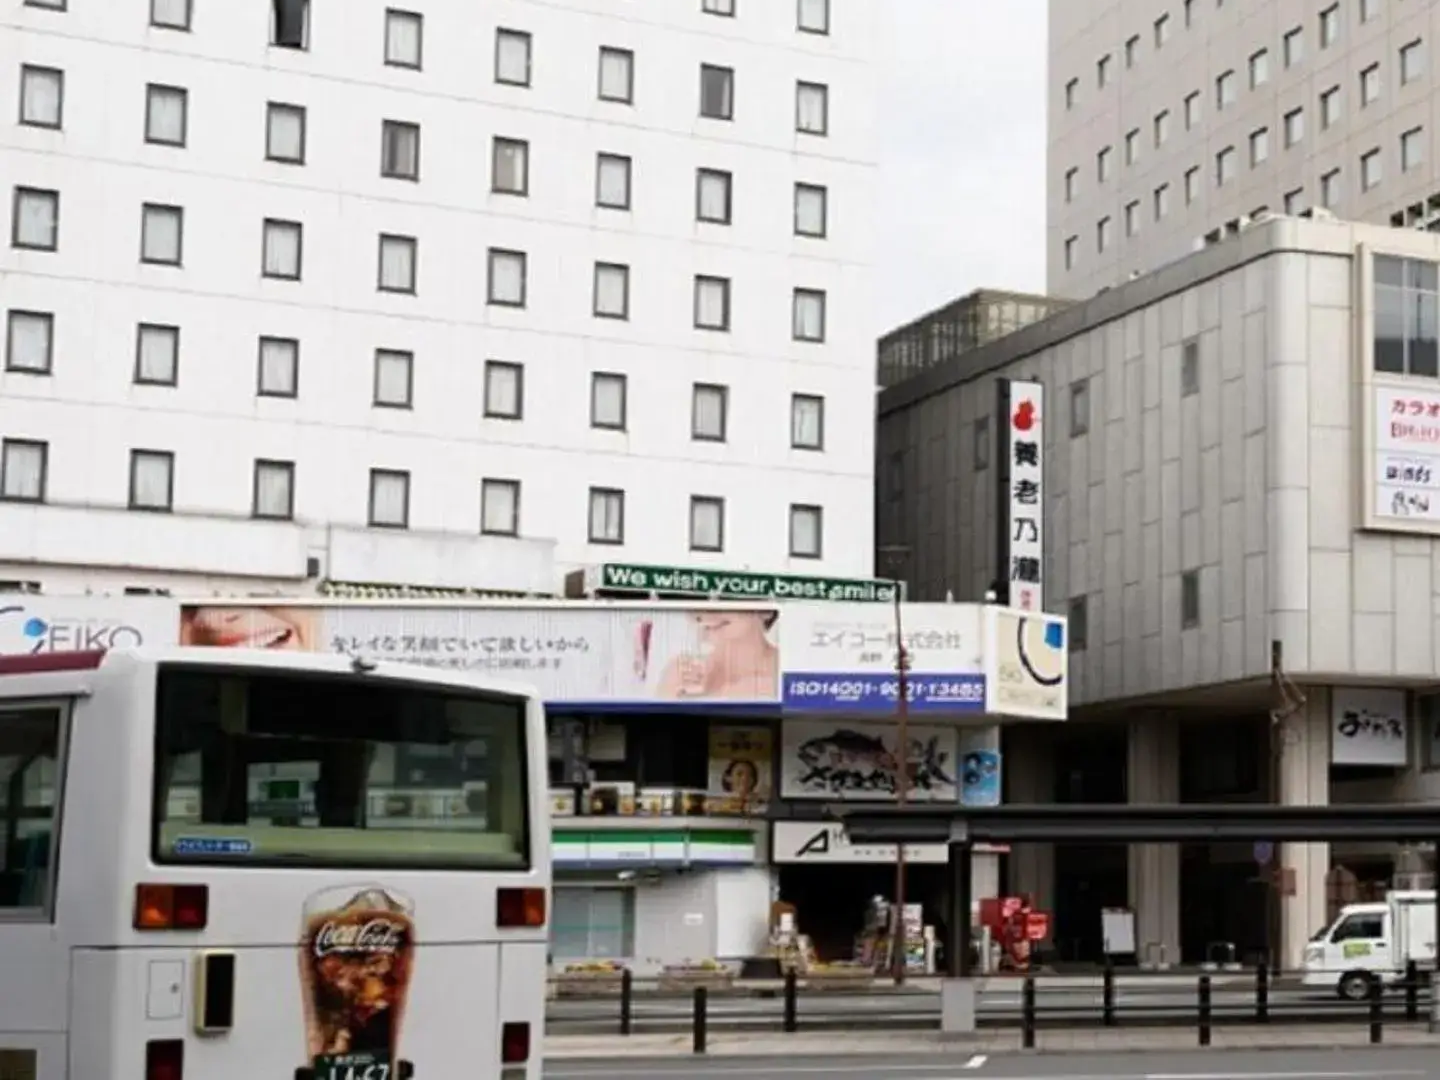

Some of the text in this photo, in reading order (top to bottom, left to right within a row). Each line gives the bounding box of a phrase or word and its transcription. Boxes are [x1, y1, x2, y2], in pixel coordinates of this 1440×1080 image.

[607, 567, 647, 586] We
[650, 570, 708, 591] wish
[713, 575, 767, 594] your
[773, 576, 827, 596] best
